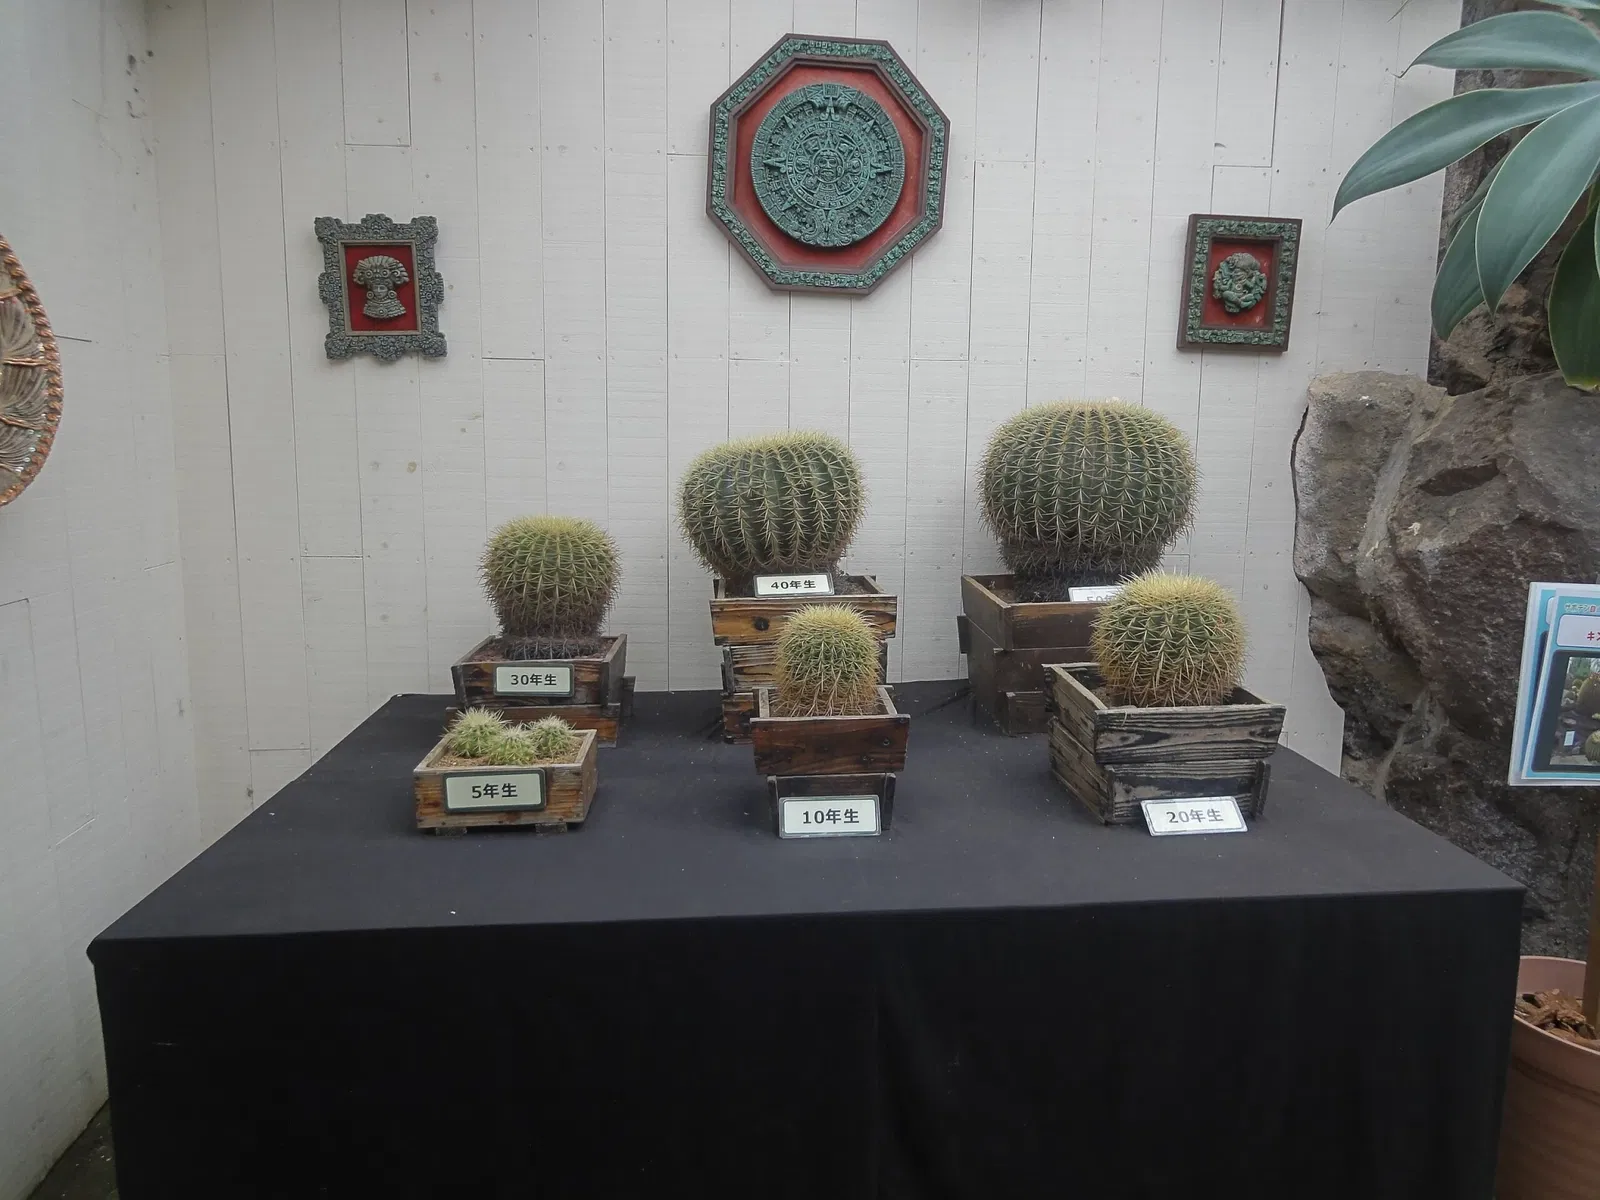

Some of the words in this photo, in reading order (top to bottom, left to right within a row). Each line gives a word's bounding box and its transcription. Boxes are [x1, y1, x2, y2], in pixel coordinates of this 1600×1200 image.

[770, 579, 817, 590] 40年生
[510, 673, 557, 686] 30年生
[471, 783, 518, 799] 5年生
[802, 808, 860, 825] 10年生
[1165, 808, 1224, 824] 20年生
